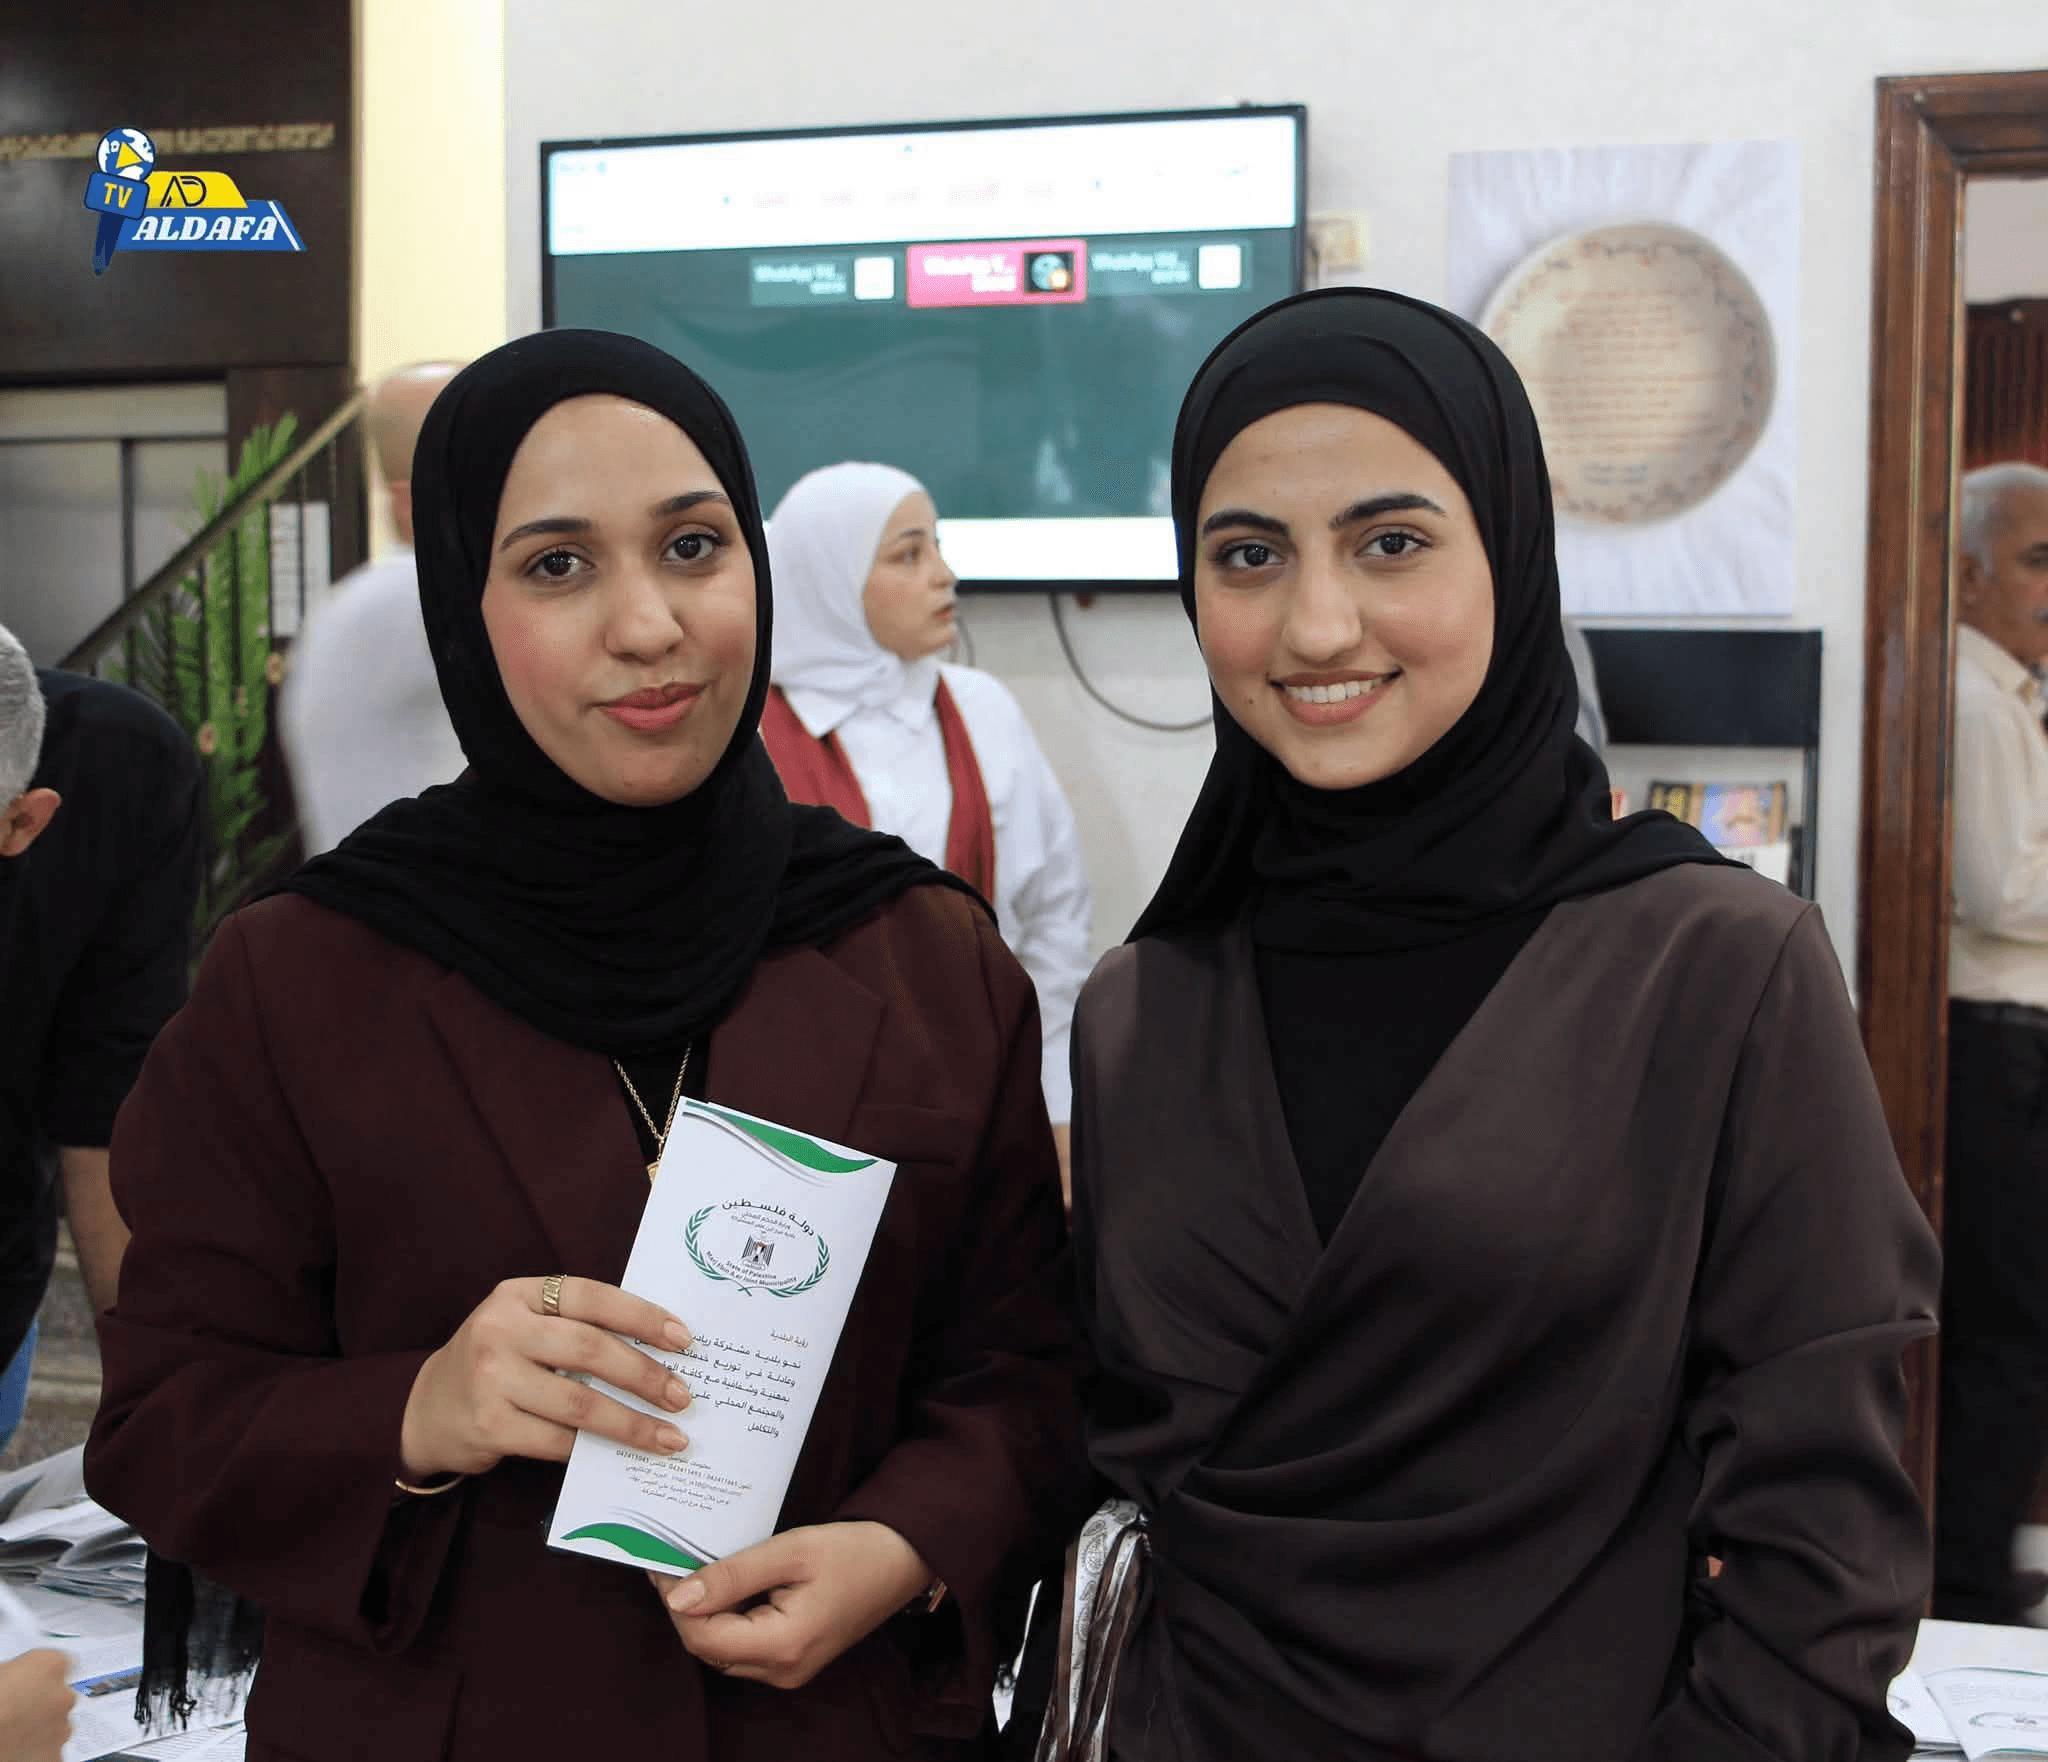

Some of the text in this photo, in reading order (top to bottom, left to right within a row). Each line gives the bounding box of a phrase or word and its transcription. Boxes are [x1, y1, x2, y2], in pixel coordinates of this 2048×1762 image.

[721, 1198, 786, 1216] فلسطين
[726, 1260, 741, 1272] State
[748, 1268, 777, 1280] Palestine
[713, 1339, 751, 1356] مشتركة
[713, 1356, 741, 1373] توزيع
[755, 1349, 781, 1366] بلدية
[782, 1357, 801, 1370] نحو
[680, 1363, 702, 1379] كافة
[704, 1373, 720, 1385] مع
[745, 1368, 762, 1379] في
[767, 1371, 795, 1388] وعادلة
[721, 1376, 758, 1397] وشفافية
[760, 1385, 790, 1403] بمهنية
[715, 1396, 748, 1410] المحلي
[749, 1402, 785, 1421] والمجتمع
[747, 1421, 779, 1438] والتكامل
